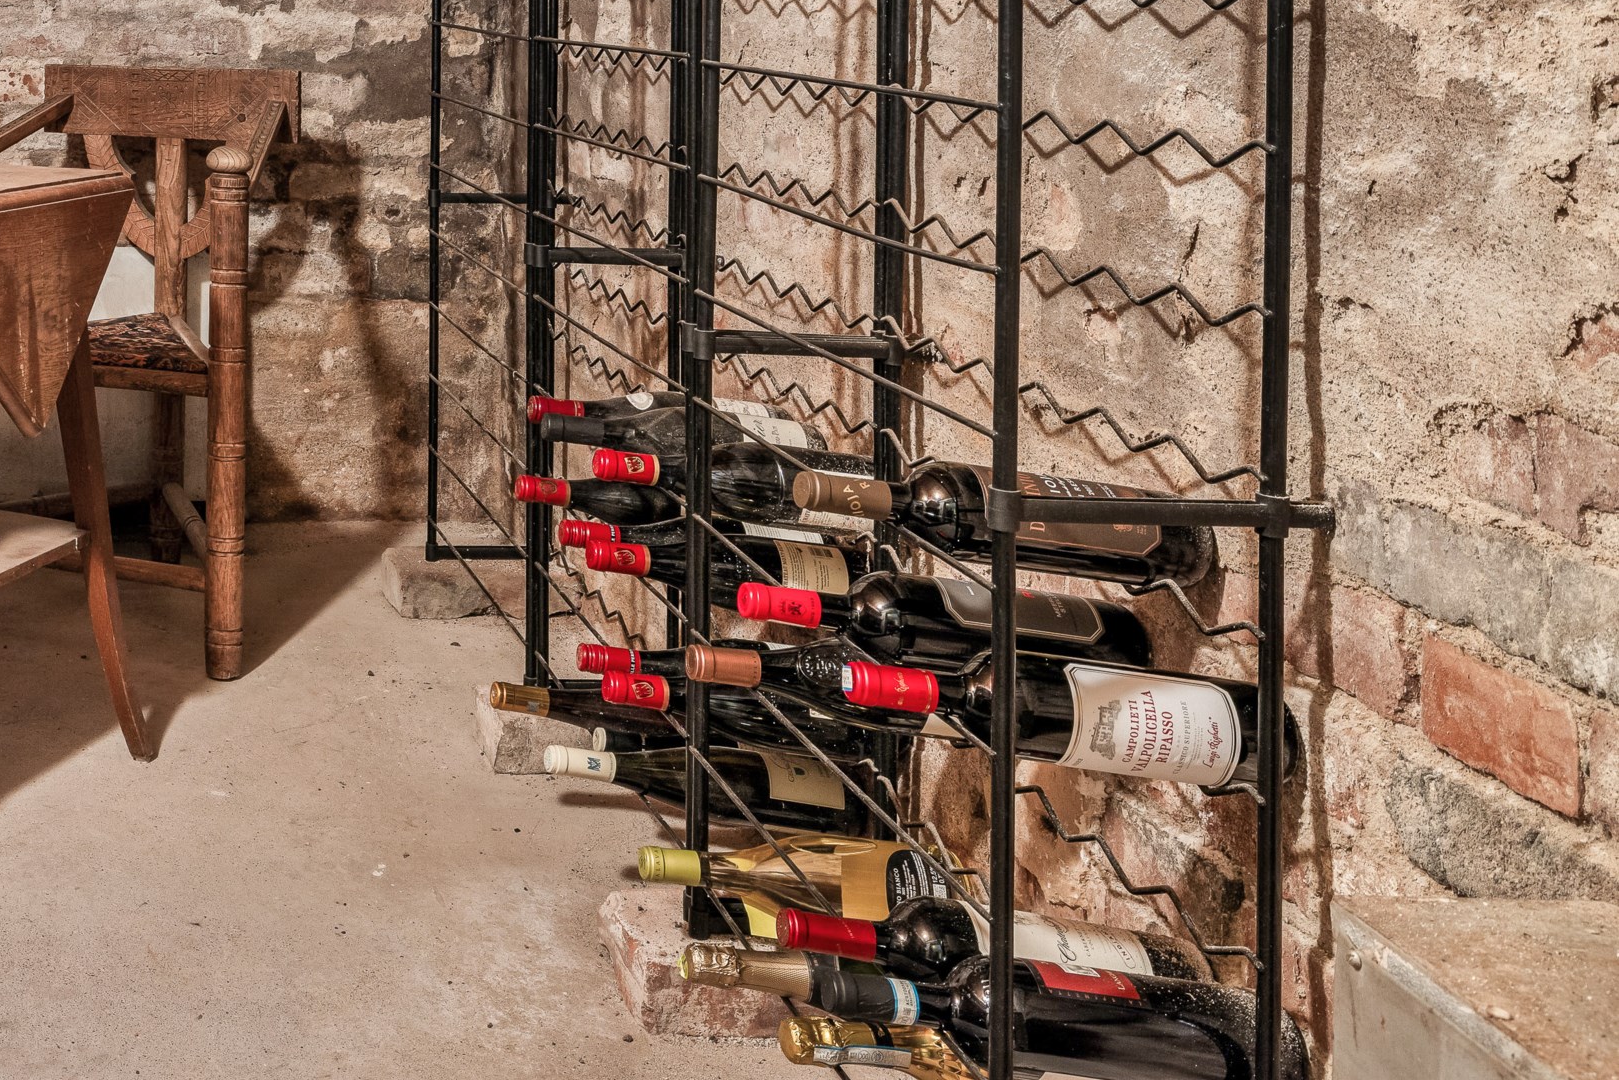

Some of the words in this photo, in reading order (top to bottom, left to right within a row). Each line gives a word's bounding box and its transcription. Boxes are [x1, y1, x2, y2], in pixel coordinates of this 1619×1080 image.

[1122, 700, 1140, 763] CAMPOLIETI
[1131, 690, 1157, 772] VALPOLICELLA
[1155, 712, 1173, 763] RIPASSO
[1180, 700, 1191, 744] SUPERIORE
[1173, 745, 1190, 775] CLASSICO
[893, 867, 902, 894] BIANCO
